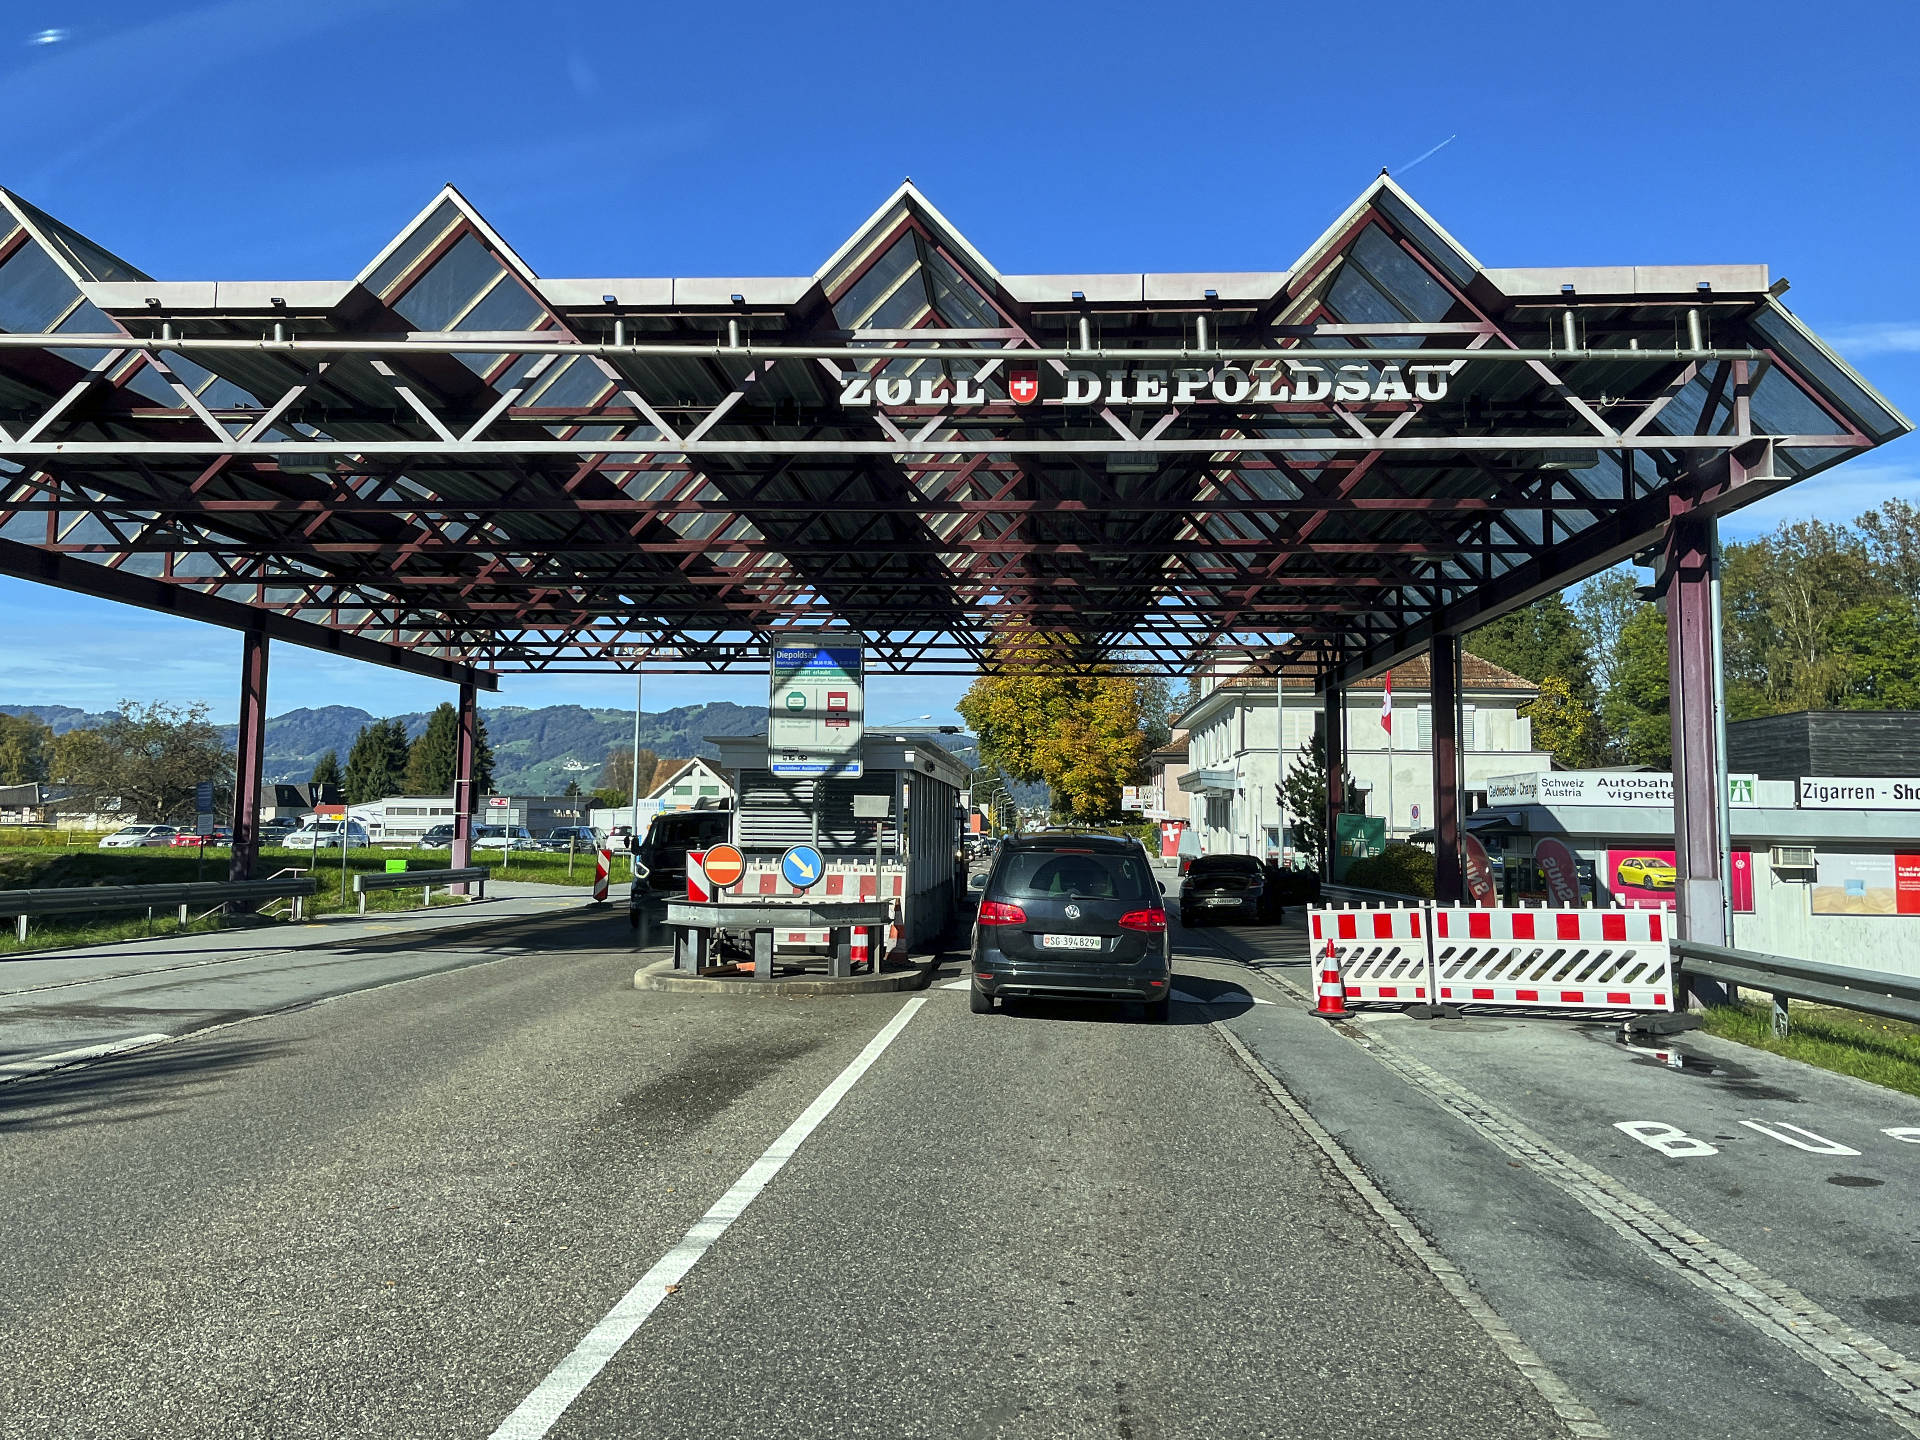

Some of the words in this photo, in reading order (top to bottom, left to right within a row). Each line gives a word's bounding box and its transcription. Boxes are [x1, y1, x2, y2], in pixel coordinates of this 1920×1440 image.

[840, 371, 985, 405] ZOLL
[1063, 365, 1452, 406] DIEPOLDSAU
[777, 651, 817, 660] Diepoldsau
[1541, 778, 1585, 788] Schweiz
[1597, 778, 1674, 788] Autobah
[1520, 782, 1537, 798] Change
[1545, 788, 1582, 797] Austria
[1803, 783, 1875, 802] Zigarren
